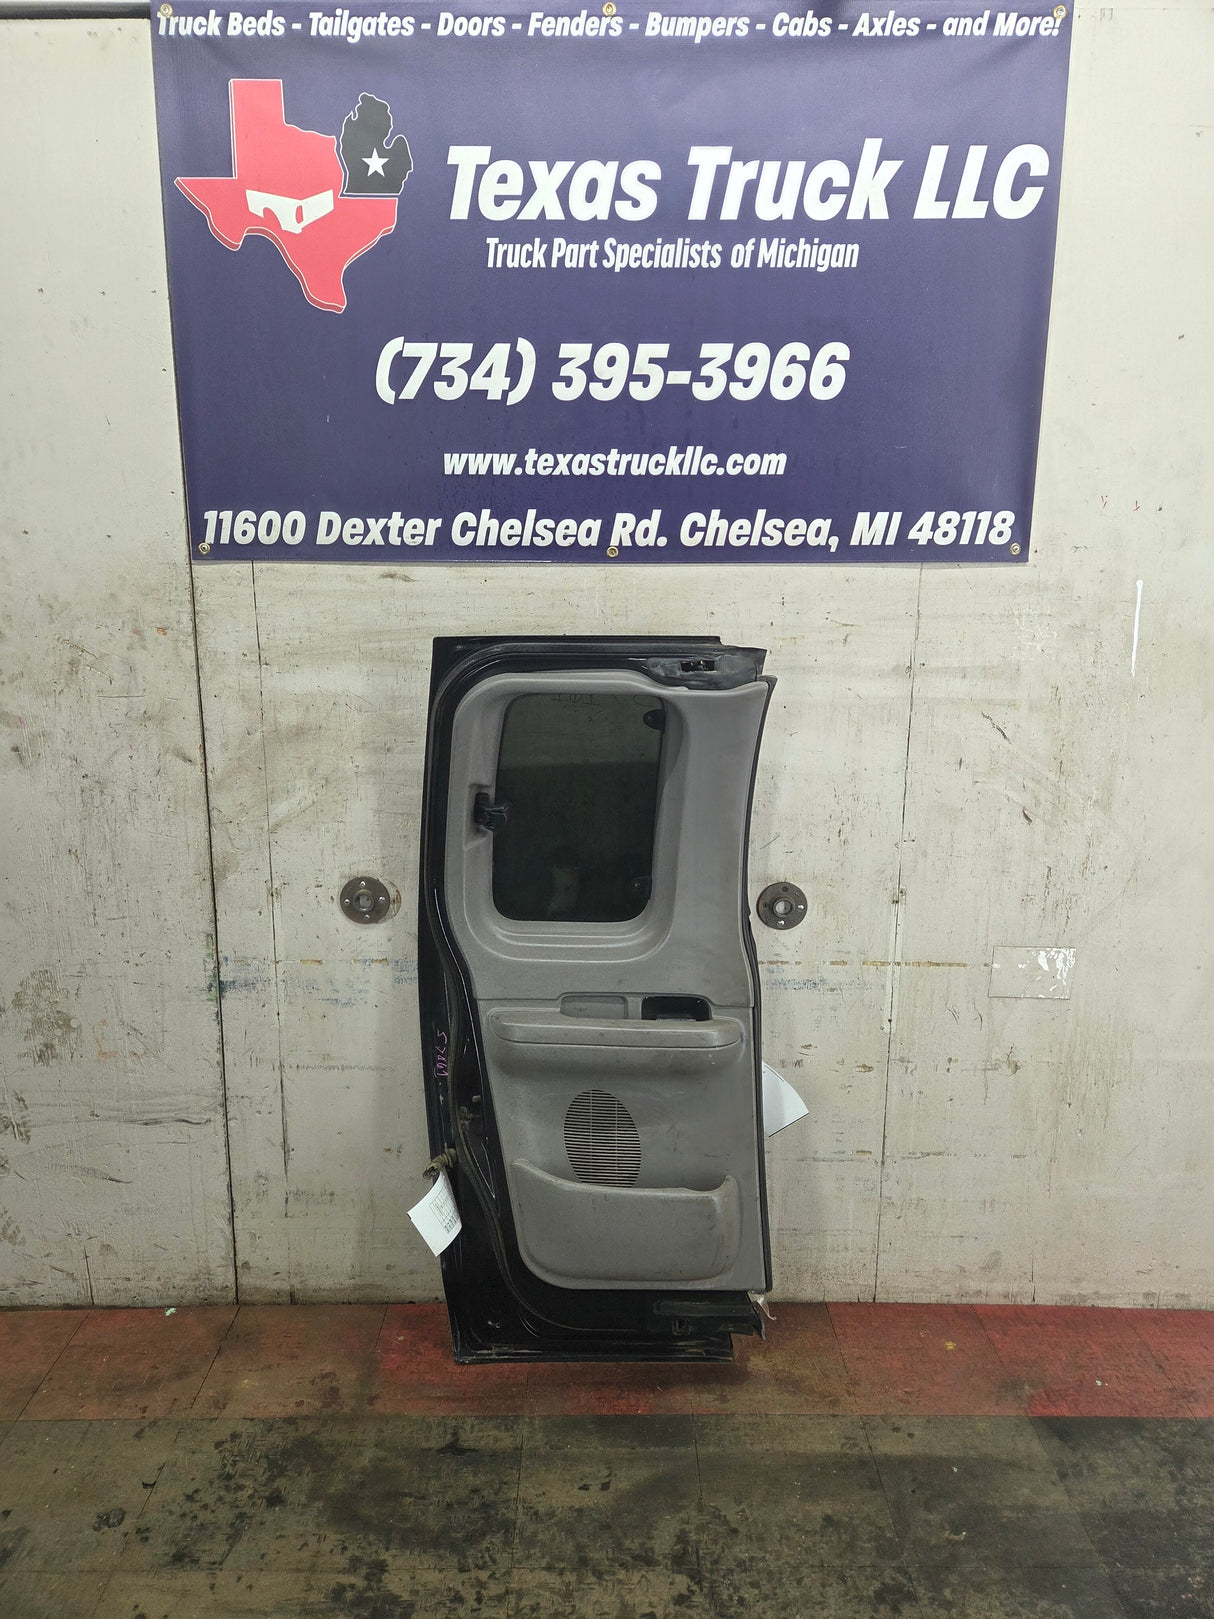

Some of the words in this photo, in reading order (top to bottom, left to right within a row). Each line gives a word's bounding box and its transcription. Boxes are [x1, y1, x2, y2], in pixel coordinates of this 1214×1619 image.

[156, 9, 222, 36] Truck
[227, 10, 285, 37] Beds
[308, 9, 415, 43] Tailgates
[437, 11, 506, 37] Doors
[527, 10, 623, 37] Fenders
[645, 11, 750, 43] Bumpers
[772, 10, 832, 37] Cabs
[851, 10, 921, 37] Axles
[942, 10, 990, 37] and
[992, 12, 1063, 37] More!
[446, 145, 662, 221] Texas
[687, 137, 904, 221] Truck
[913, 143, 1050, 220] LLC
[486, 237, 547, 269] Truck
[550, 237, 599, 269] Part
[602, 237, 722, 273] Specialists
[730, 237, 756, 269] of
[756, 237, 860, 273] Michigan
[376, 336, 537, 406] (734)
[551, 341, 851, 402] 395-3966
[443, 445, 788, 476] www.texastruckllc.com
[202, 510, 307, 545] 11600
[315, 511, 443, 546] Dexter
[451, 508, 602, 547] Chelsea
[610, 509, 668, 547] Rd.
[680, 508, 840, 553] Chelsea,
[849, 511, 903, 546] MI
[907, 510, 1016, 546] 48118
